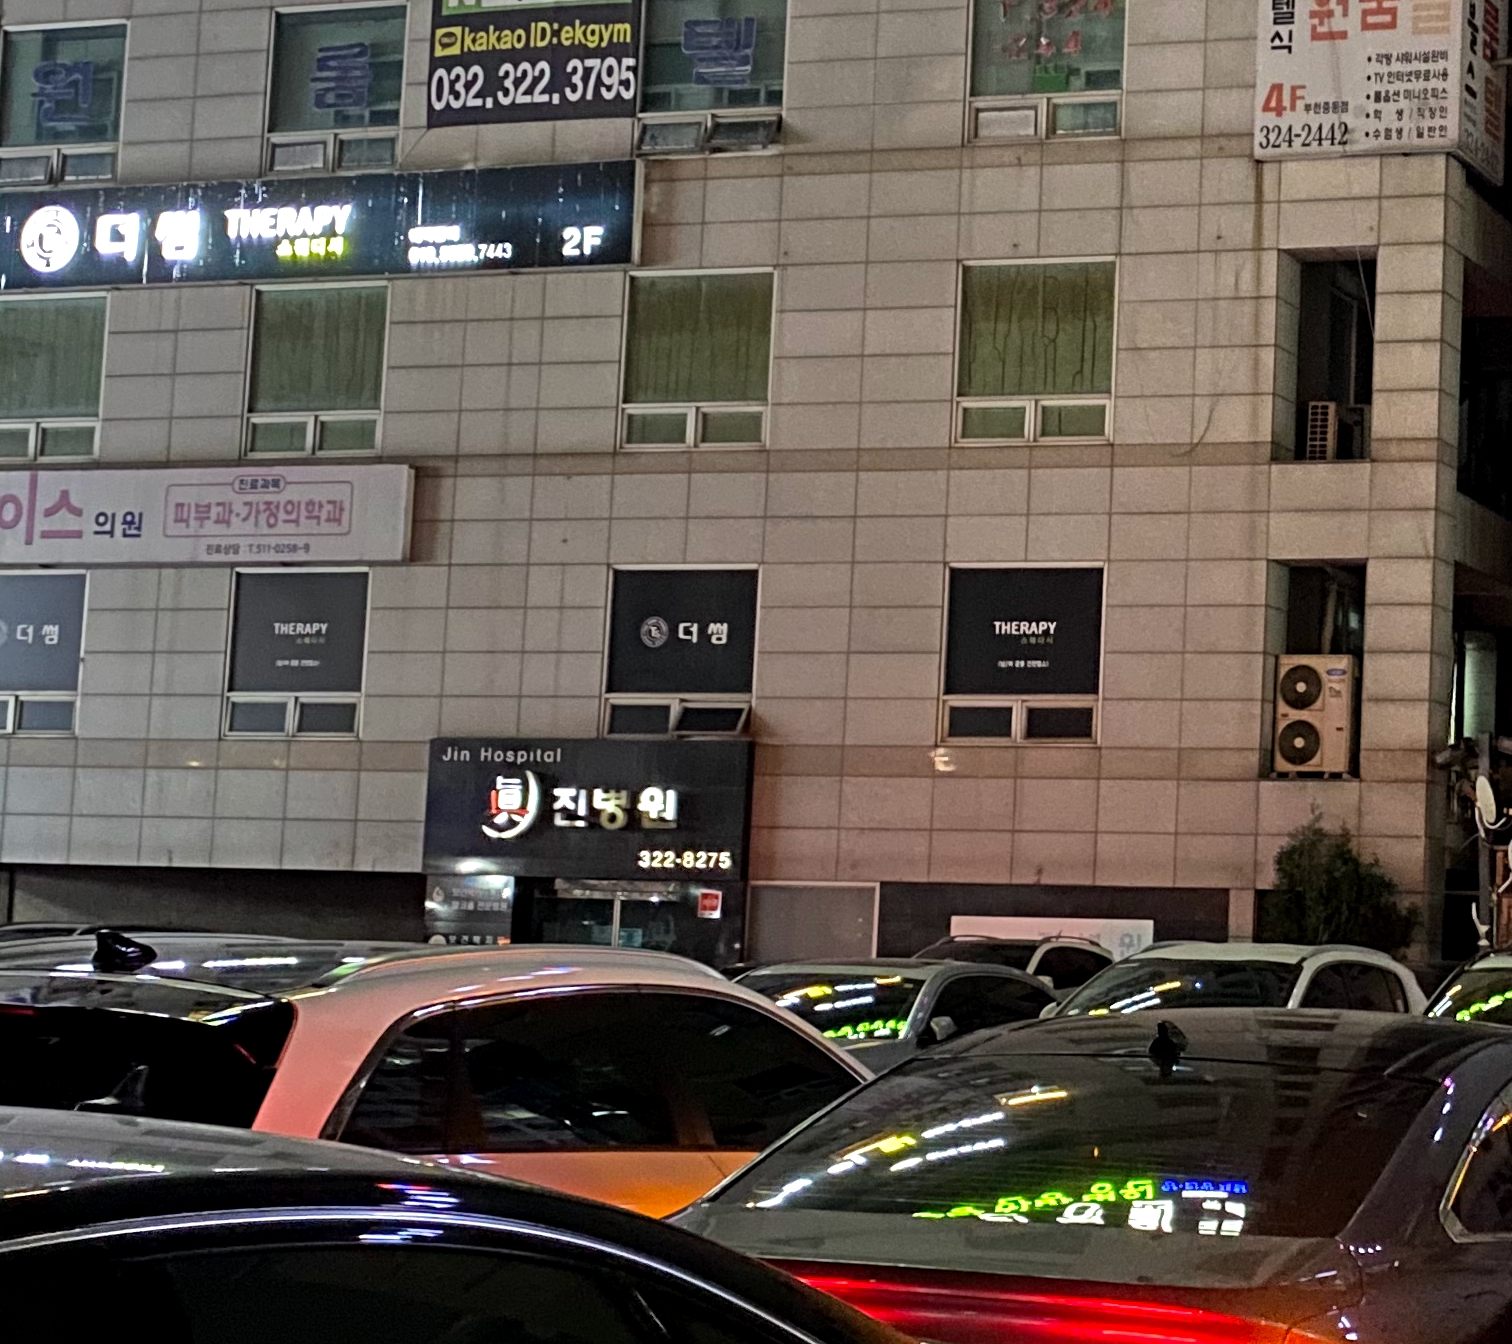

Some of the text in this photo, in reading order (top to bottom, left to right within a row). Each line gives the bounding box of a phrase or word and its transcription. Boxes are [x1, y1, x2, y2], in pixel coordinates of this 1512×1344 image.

[464, 25, 527, 53] kakao
[430, 56, 636, 111] 032.322.3795
[1374, 72, 1385, 84] TV
[1262, 82, 1307, 117] 4F
[1259, 122, 1349, 150] 324-2442
[224, 204, 351, 239] THERAPY
[562, 225, 605, 256] 2F
[93, 511, 144, 539] 의원
[273, 622, 328, 635] THERAPY
[993, 621, 1057, 635] THERAPY
[442, 747, 562, 766] Jin Hospital
[553, 786, 679, 831] 진병원
[637, 850, 733, 870] 322-8275
